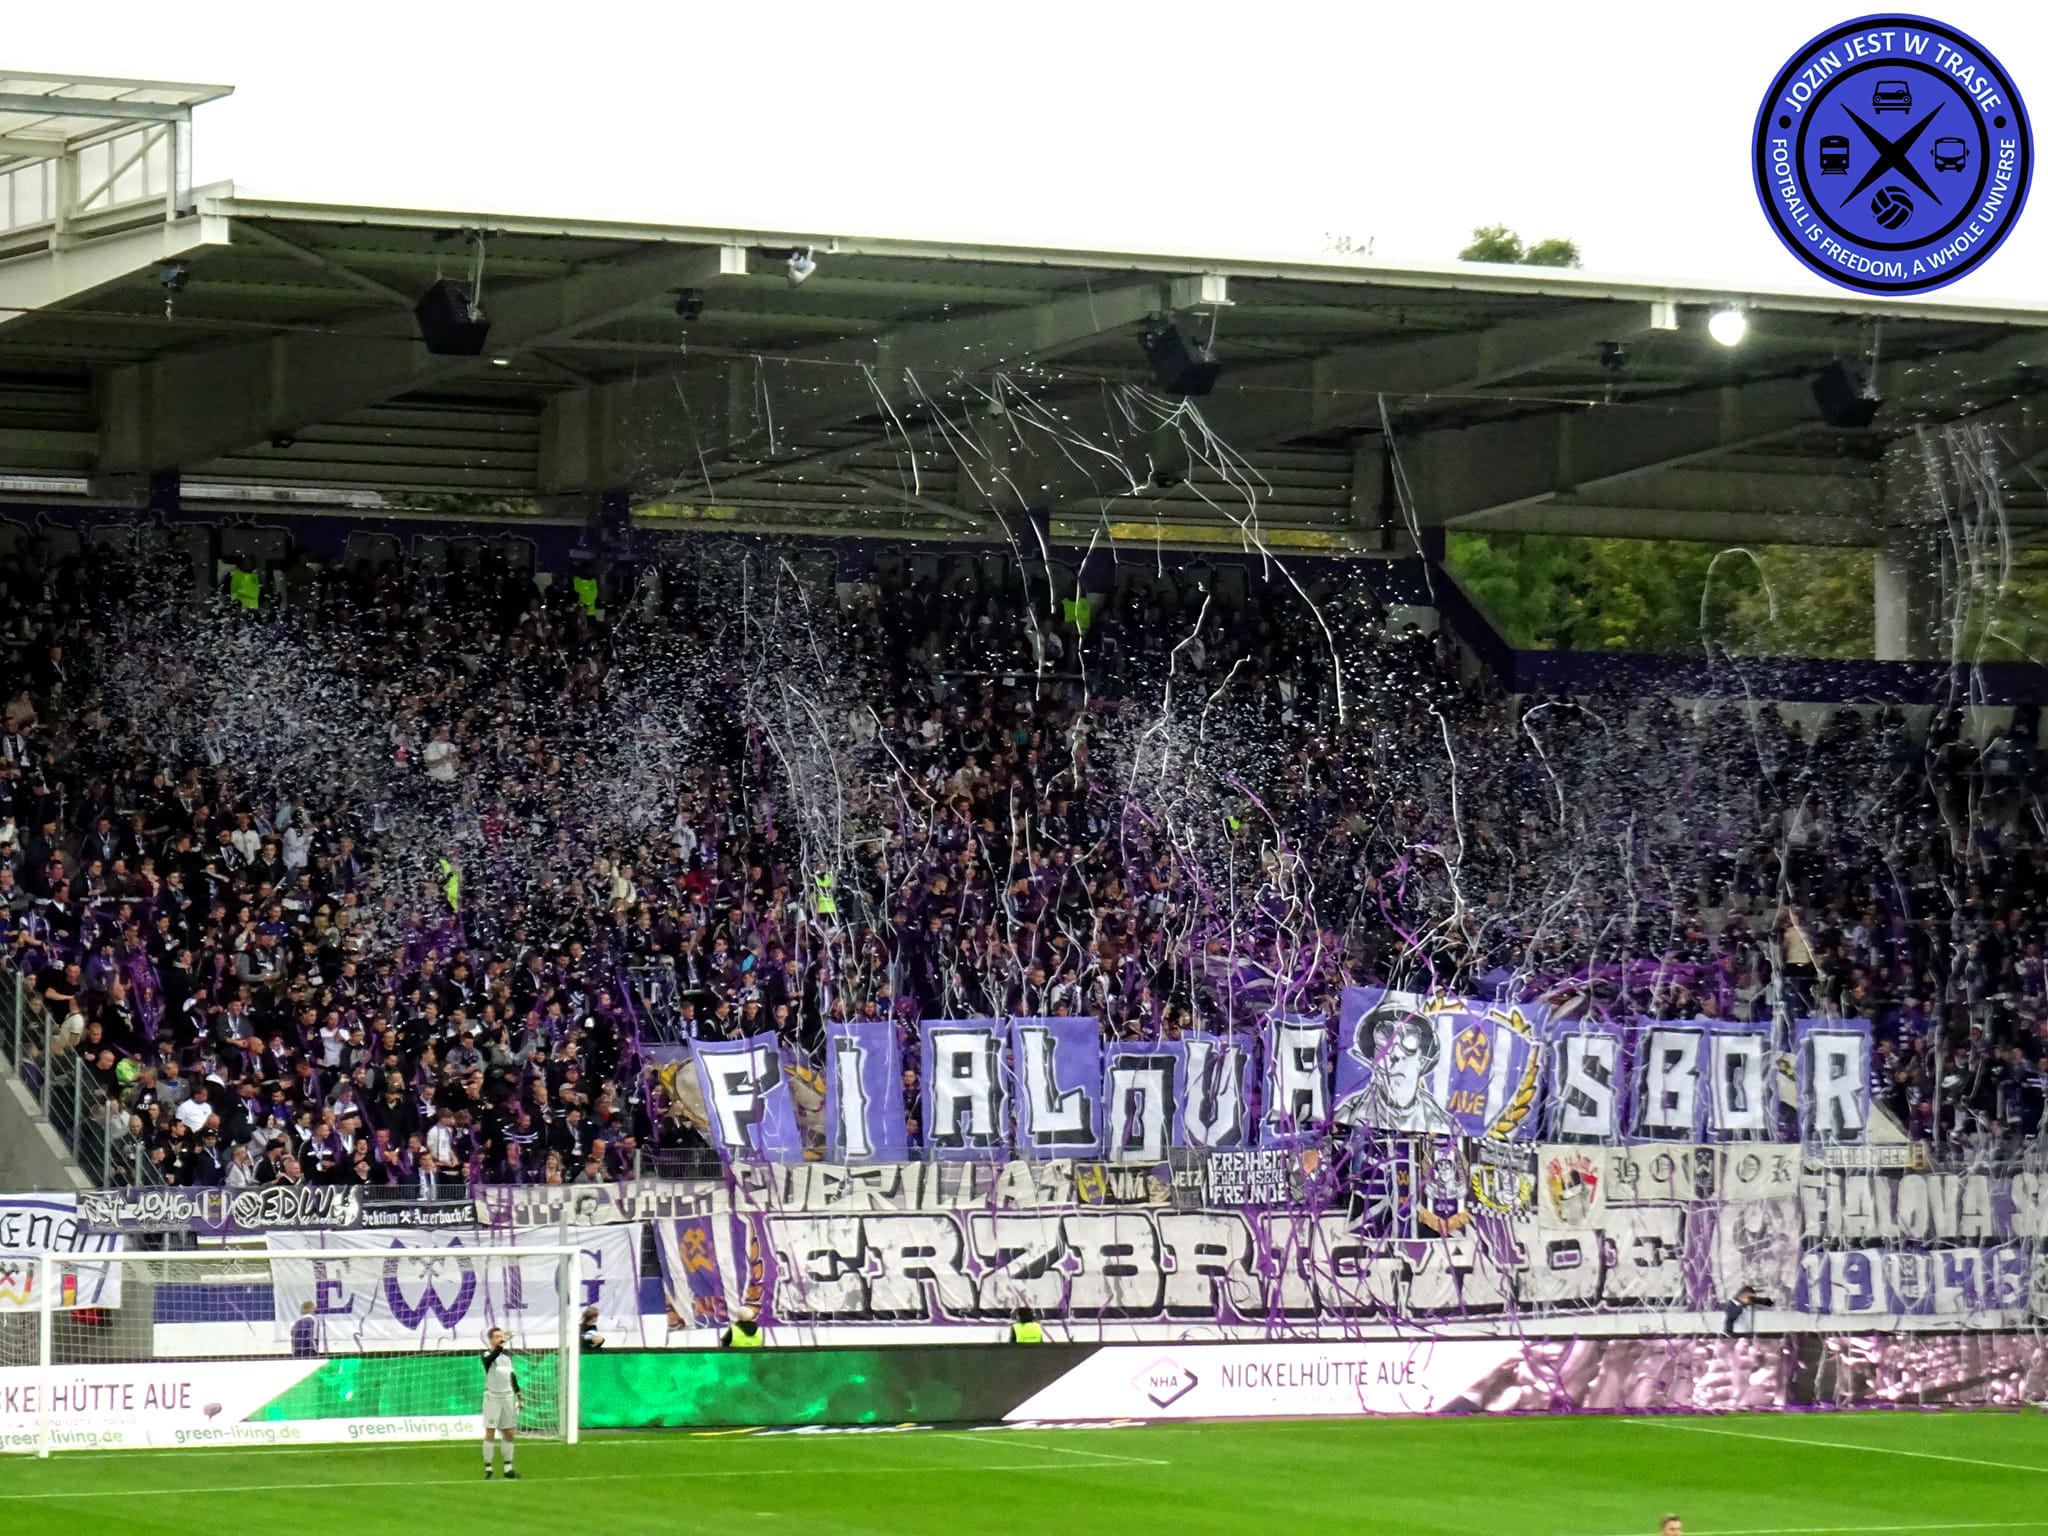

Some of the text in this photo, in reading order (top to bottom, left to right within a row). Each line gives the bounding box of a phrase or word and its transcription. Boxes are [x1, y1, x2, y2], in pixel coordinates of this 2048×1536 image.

[1212, 1150, 1288, 1171] FREIHEIT
[733, 1158, 1078, 1213] GUERILLAS
[1801, 1173, 1993, 1238] FIALOVA
[768, 1204, 1686, 1324] ERZBRIGADE
[1150, 1375, 1178, 1388] NHA
[1221, 1357, 1416, 1388] NICKELHÜTTE AUE
[0, 1378, 192, 1413] KEHÜTTE AUE
[175, 1425, 301, 1443] green-living.de
[347, 1420, 474, 1438] green-living.de
